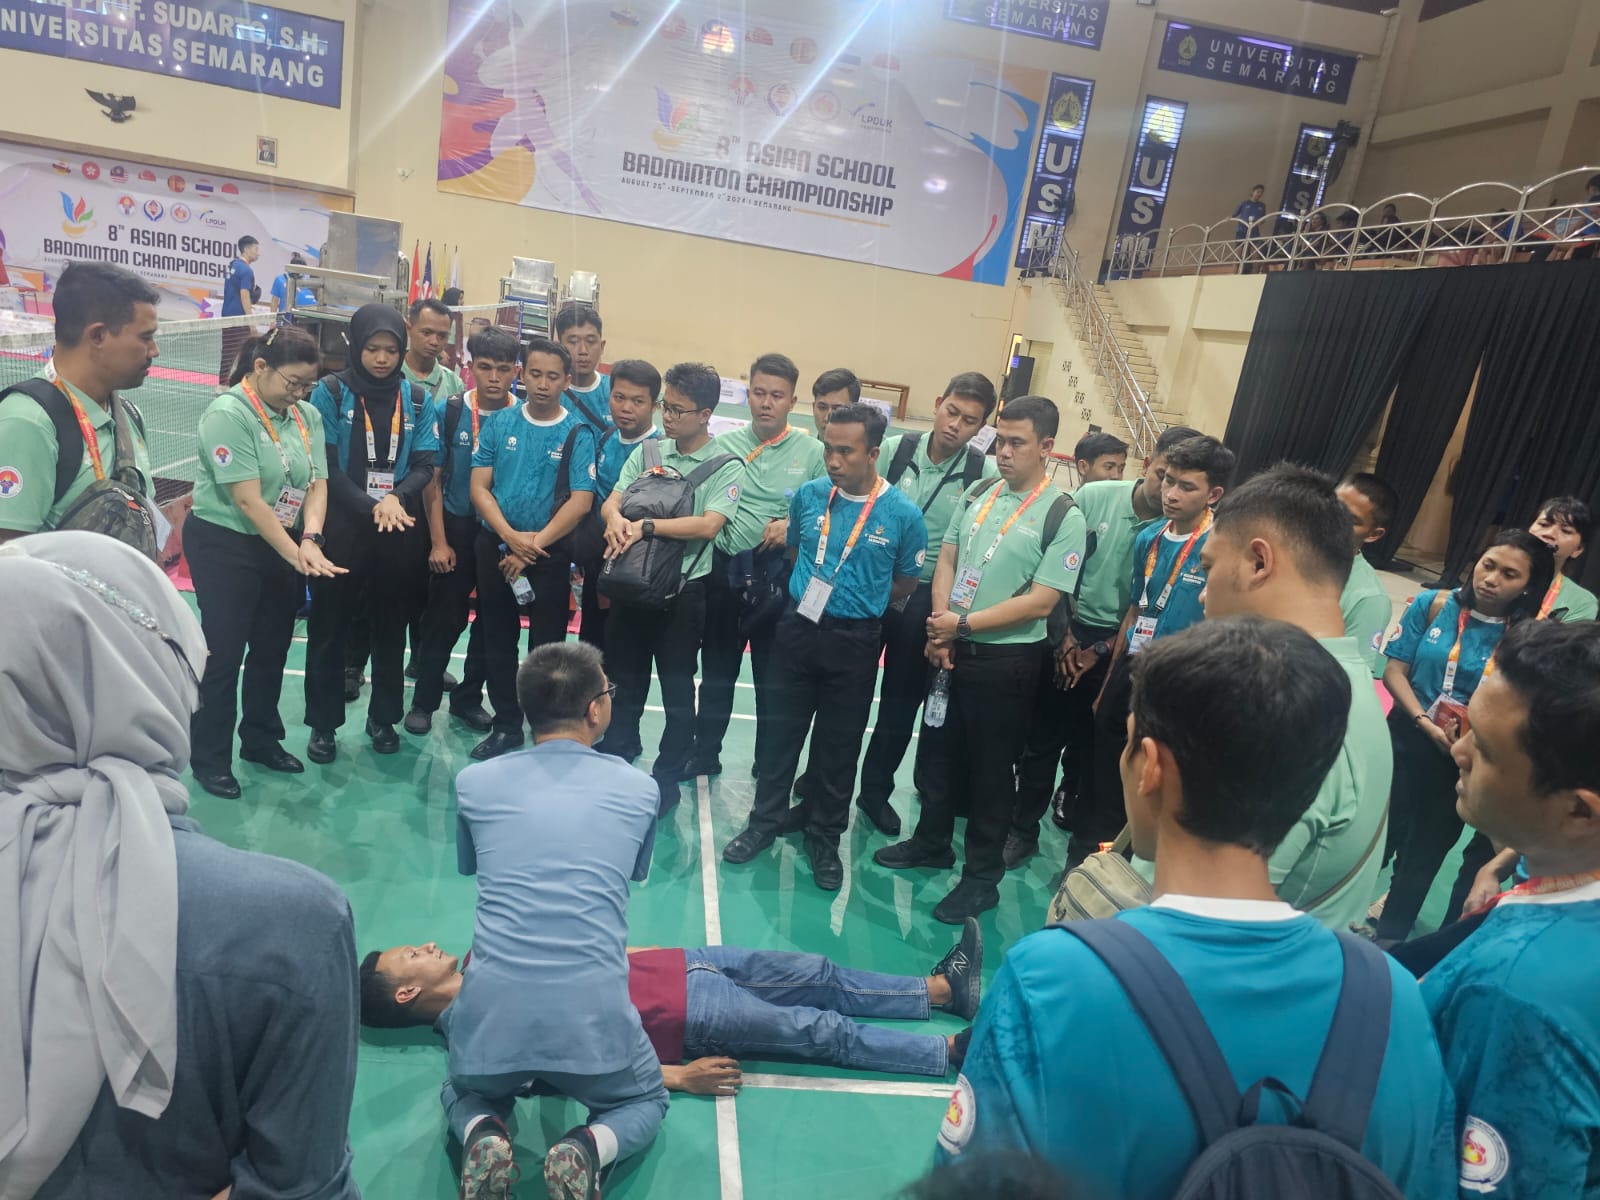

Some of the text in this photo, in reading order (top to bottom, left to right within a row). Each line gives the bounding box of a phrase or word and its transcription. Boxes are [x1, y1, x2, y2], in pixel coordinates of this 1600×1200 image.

[0, 8, 162, 57] NIVERSITAS
[984, 5, 1096, 39] SEMARANG
[280, 26, 328, 57] S.H.
[1210, 39, 1341, 77] UNIVERSITAS
[172, 38, 324, 88] SEMARANG
[1206, 57, 1336, 94] SEMARANG
[622, 151, 894, 217] BADMINTON CHAMPIONSHIP
[816, 153, 897, 189] SCHOOL
[43, 236, 232, 279] BADMINTON CHAMPIONSH
[130, 228, 177, 250] ASIAN
[181, 235, 239, 259] SCHOOL
